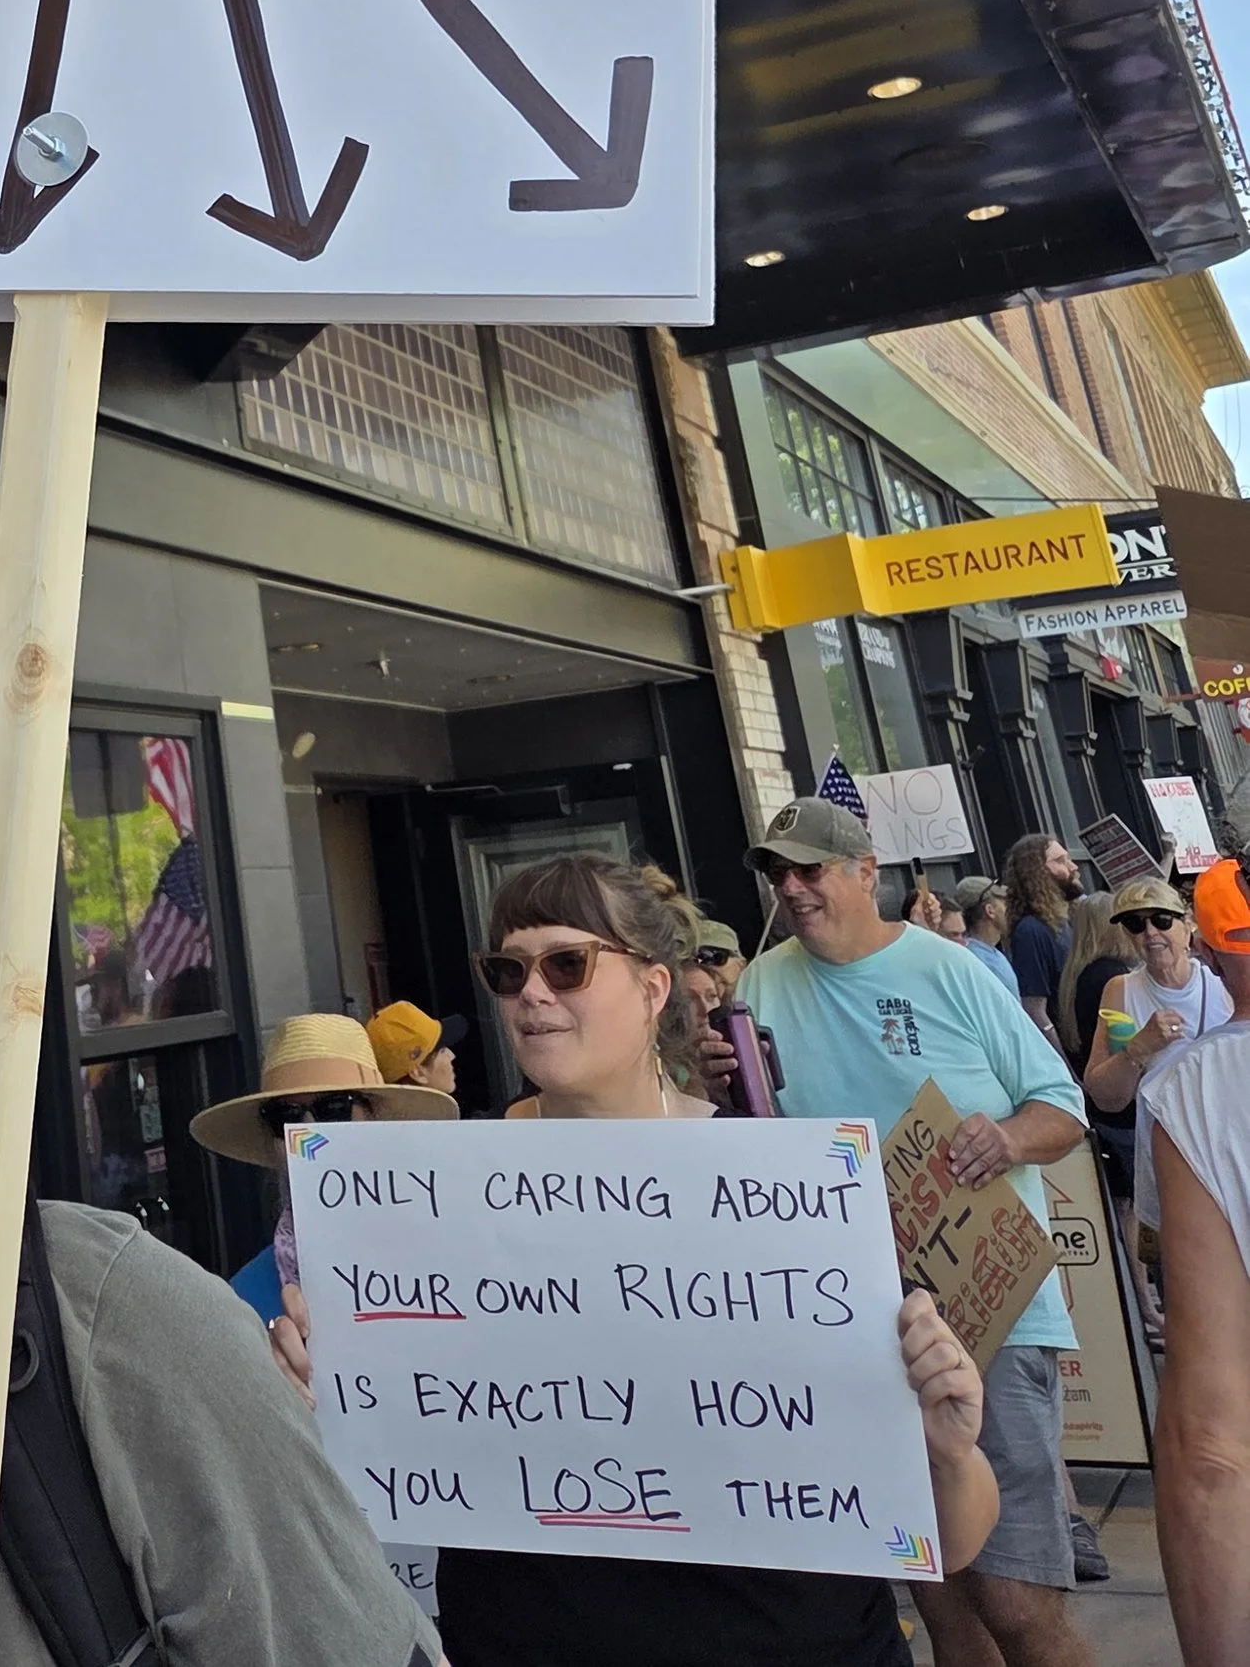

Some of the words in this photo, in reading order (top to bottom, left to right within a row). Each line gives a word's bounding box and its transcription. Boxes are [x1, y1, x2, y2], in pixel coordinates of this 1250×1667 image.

[885, 534, 1086, 586] RESTAURANT
[1023, 609, 1098, 633] FASHION
[1104, 598, 1185, 621] APPAREL
[866, 770, 943, 816] NO
[876, 998, 912, 1010] CABO
[883, 1119, 935, 1197] TING
[318, 1168, 440, 1217] ONLY
[484, 1171, 673, 1220] CARING
[710, 1176, 862, 1225] ABOUT
[332, 1264, 463, 1318] YOUR
[475, 1276, 582, 1315] OWN
[614, 1263, 854, 1327] RIGHTS
[334, 1372, 379, 1416] IS
[414, 1371, 636, 1429] EXACTLY
[689, 1379, 816, 1432] HOW
[364, 1465, 475, 1521] YOU
[518, 1455, 683, 1522] LOSE
[725, 1478, 870, 1529] THEM
